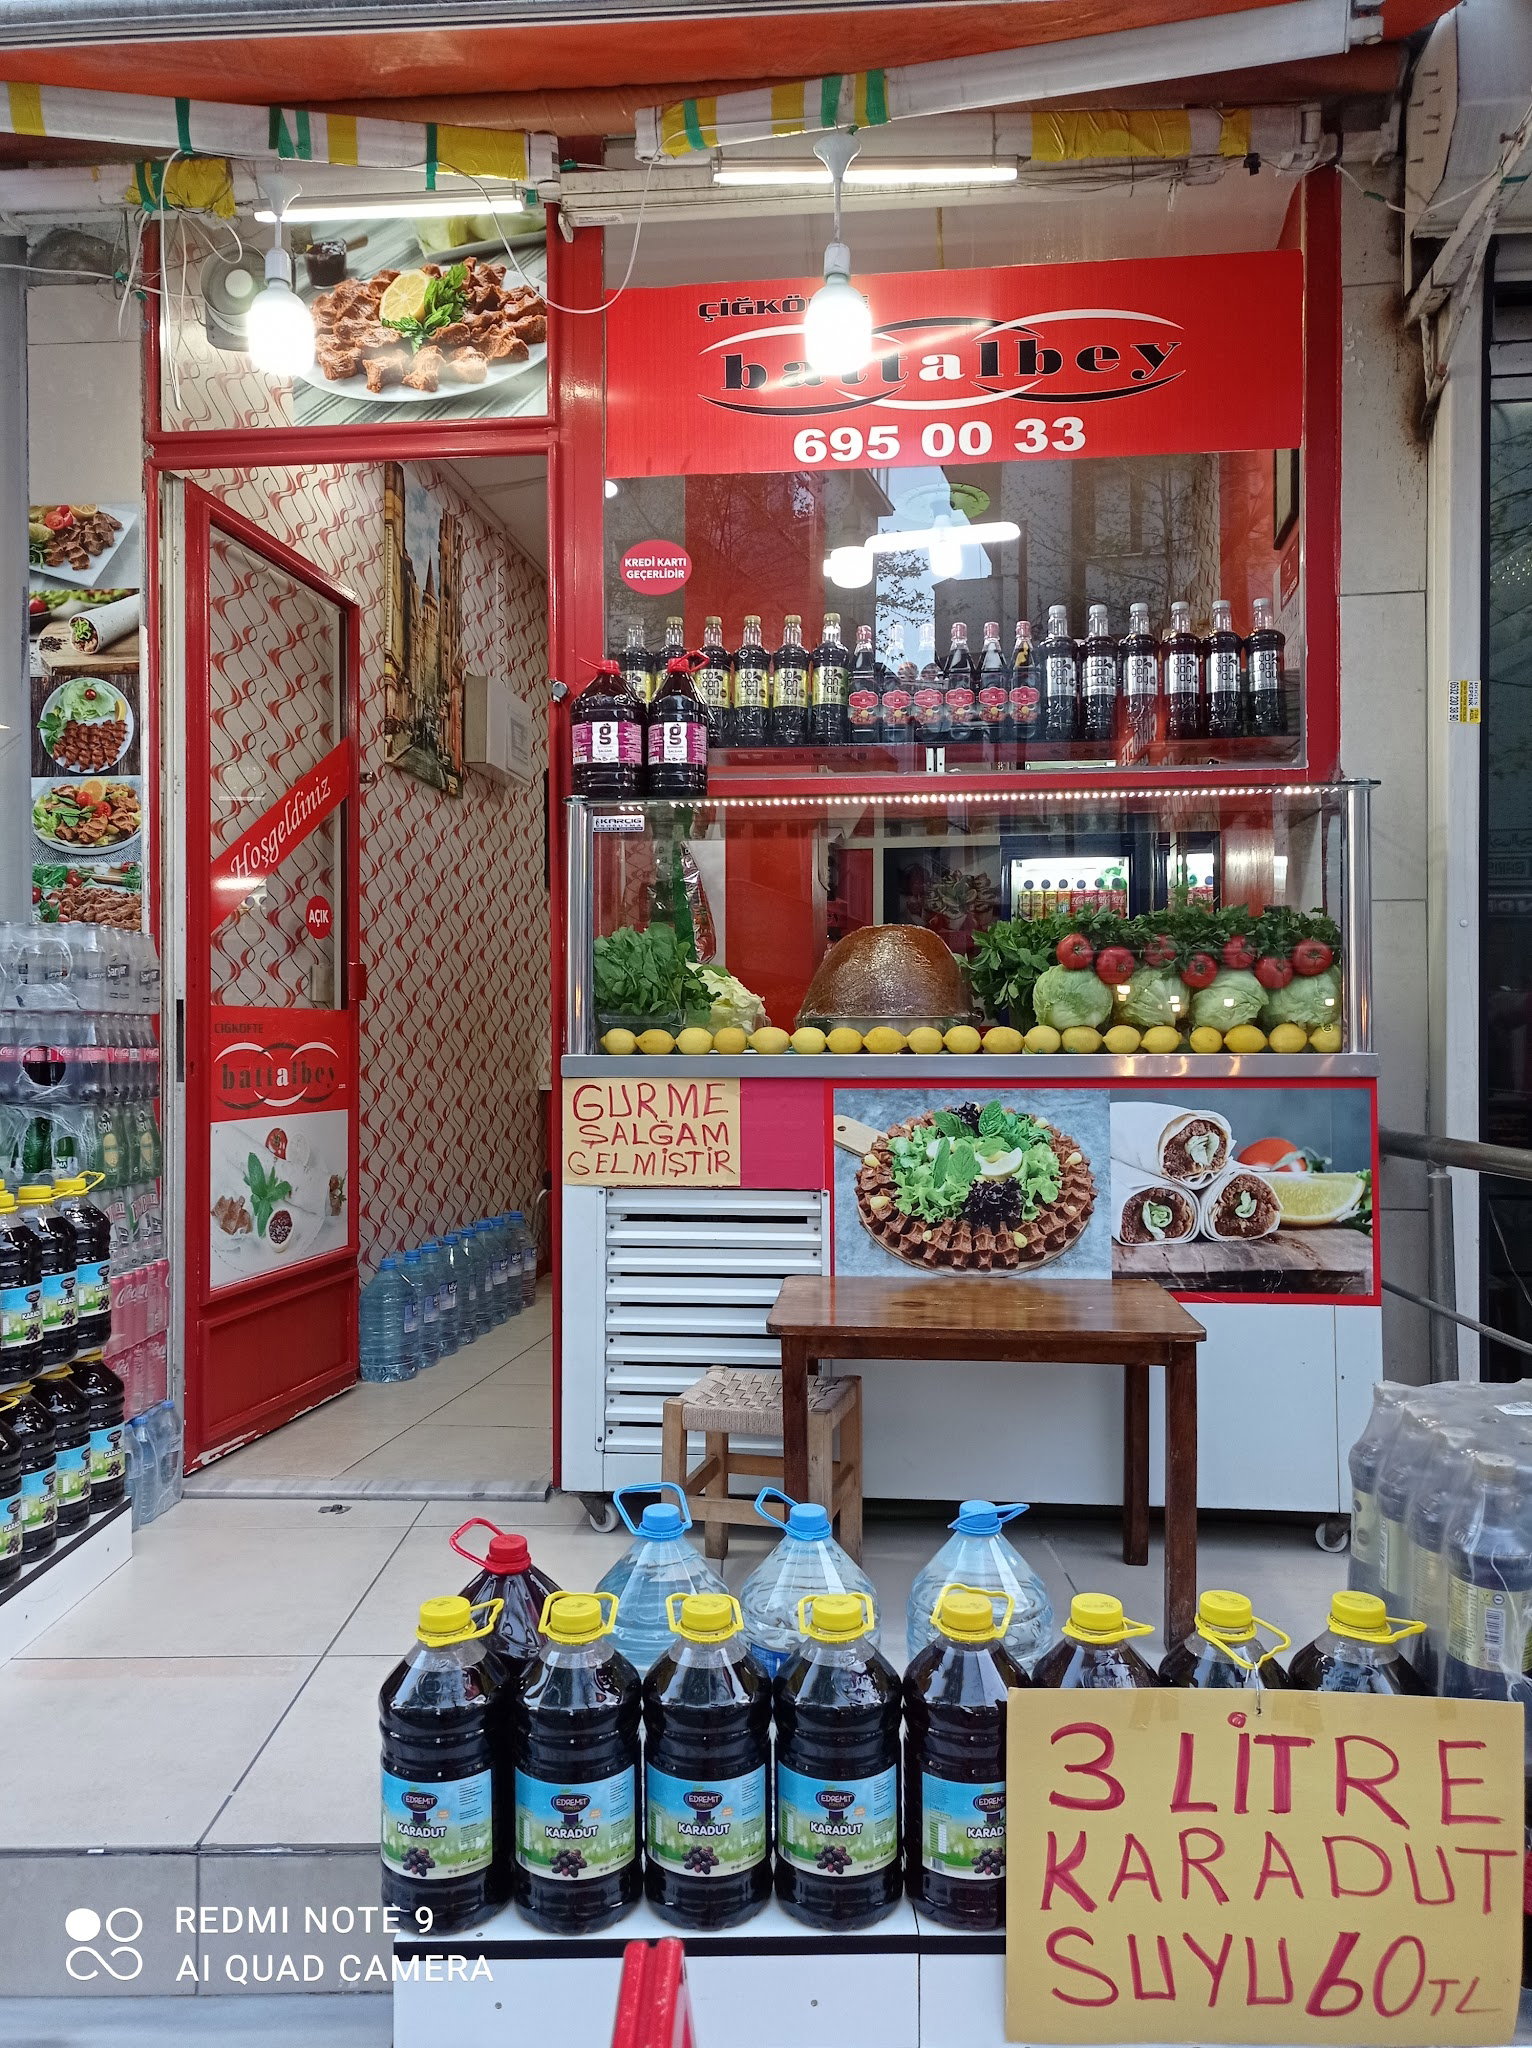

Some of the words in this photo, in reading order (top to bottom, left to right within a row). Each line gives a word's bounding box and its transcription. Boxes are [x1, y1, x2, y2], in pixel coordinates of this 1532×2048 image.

[793, 424, 901, 464] 695
[921, 420, 993, 458] 00
[1013, 416, 1086, 454] 33
[624, 555, 655, 567] KREDİ
[657, 557, 687, 567] KARTI
[625, 567, 685, 581] GEÇERLİDİR
[230, 776, 331, 878] Hoşgeldiniz
[308, 909, 329, 927] AÇIK
[572, 1082, 729, 1122] GURME
[567, 1146, 736, 1178] GELMİŞTİR
[1048, 1721, 1126, 1811] 3
[1170, 1711, 1505, 1830] LİTRE
[397, 1821, 447, 1838] KARADUT
[545, 1825, 599, 1839] KARADUT
[678, 1821, 731, 1836] KARADUT
[810, 1821, 863, 1836] KARADUT
[1040, 1827, 1519, 1916] KARADUT
[1045, 1926, 1295, 2008] SUYU
